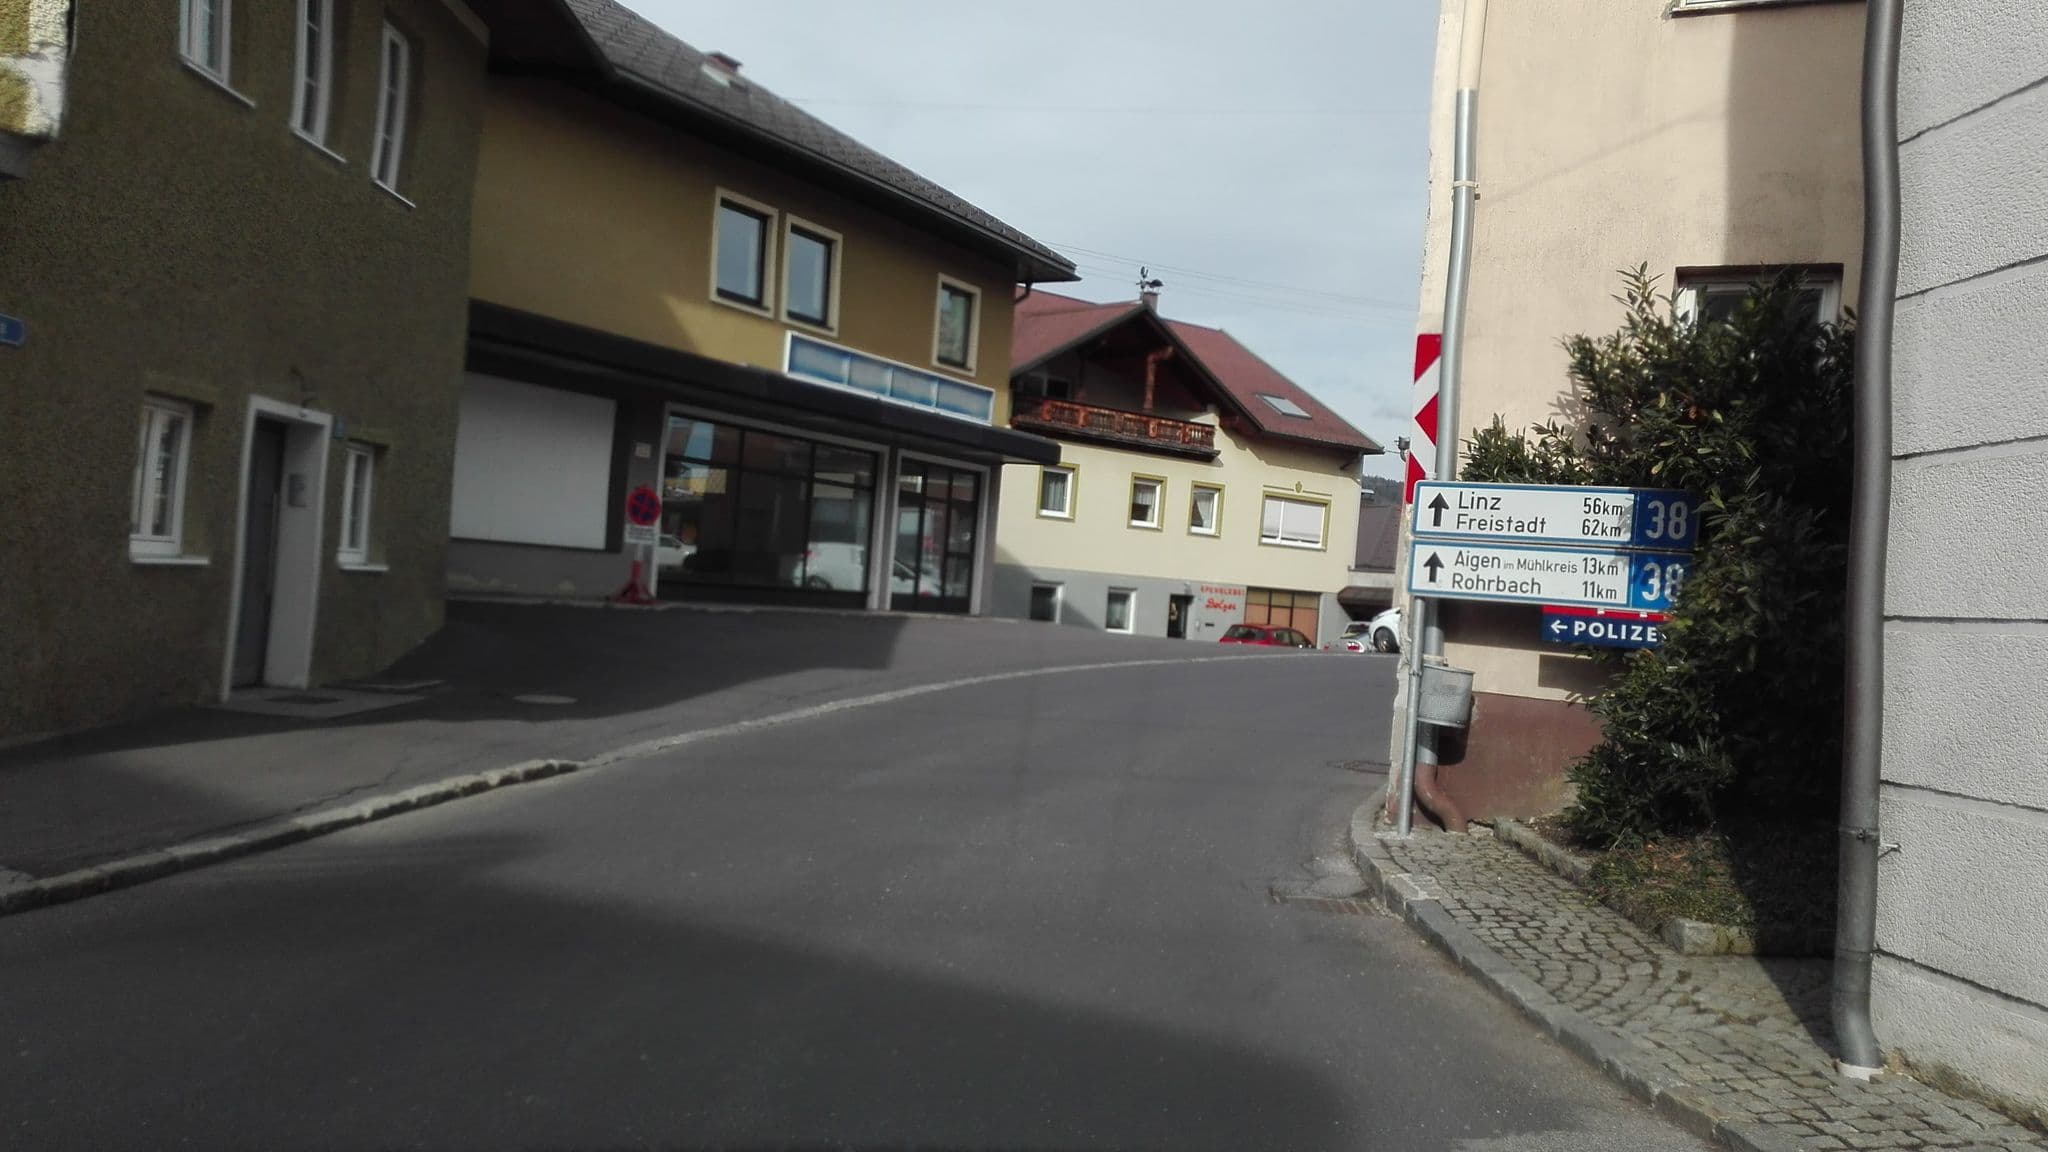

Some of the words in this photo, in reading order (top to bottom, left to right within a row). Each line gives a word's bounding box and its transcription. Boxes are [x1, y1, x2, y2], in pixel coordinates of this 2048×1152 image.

[1458, 491, 1502, 510] Linz
[1583, 497, 1624, 516] 56km
[1456, 514, 1546, 534] Freistadt
[1581, 518, 1622, 537] 62km
[1645, 500, 1688, 540] 38
[1454, 551, 1501, 571] Aigen
[1517, 558, 1578, 574] Mühlkreis
[1582, 557, 1619, 576] 13km
[1452, 573, 1542, 595] Rohrbach
[1582, 581, 1618, 600] 11km
[1641, 562, 1684, 602] 38
[1574, 620, 1667, 643] POLIZE
